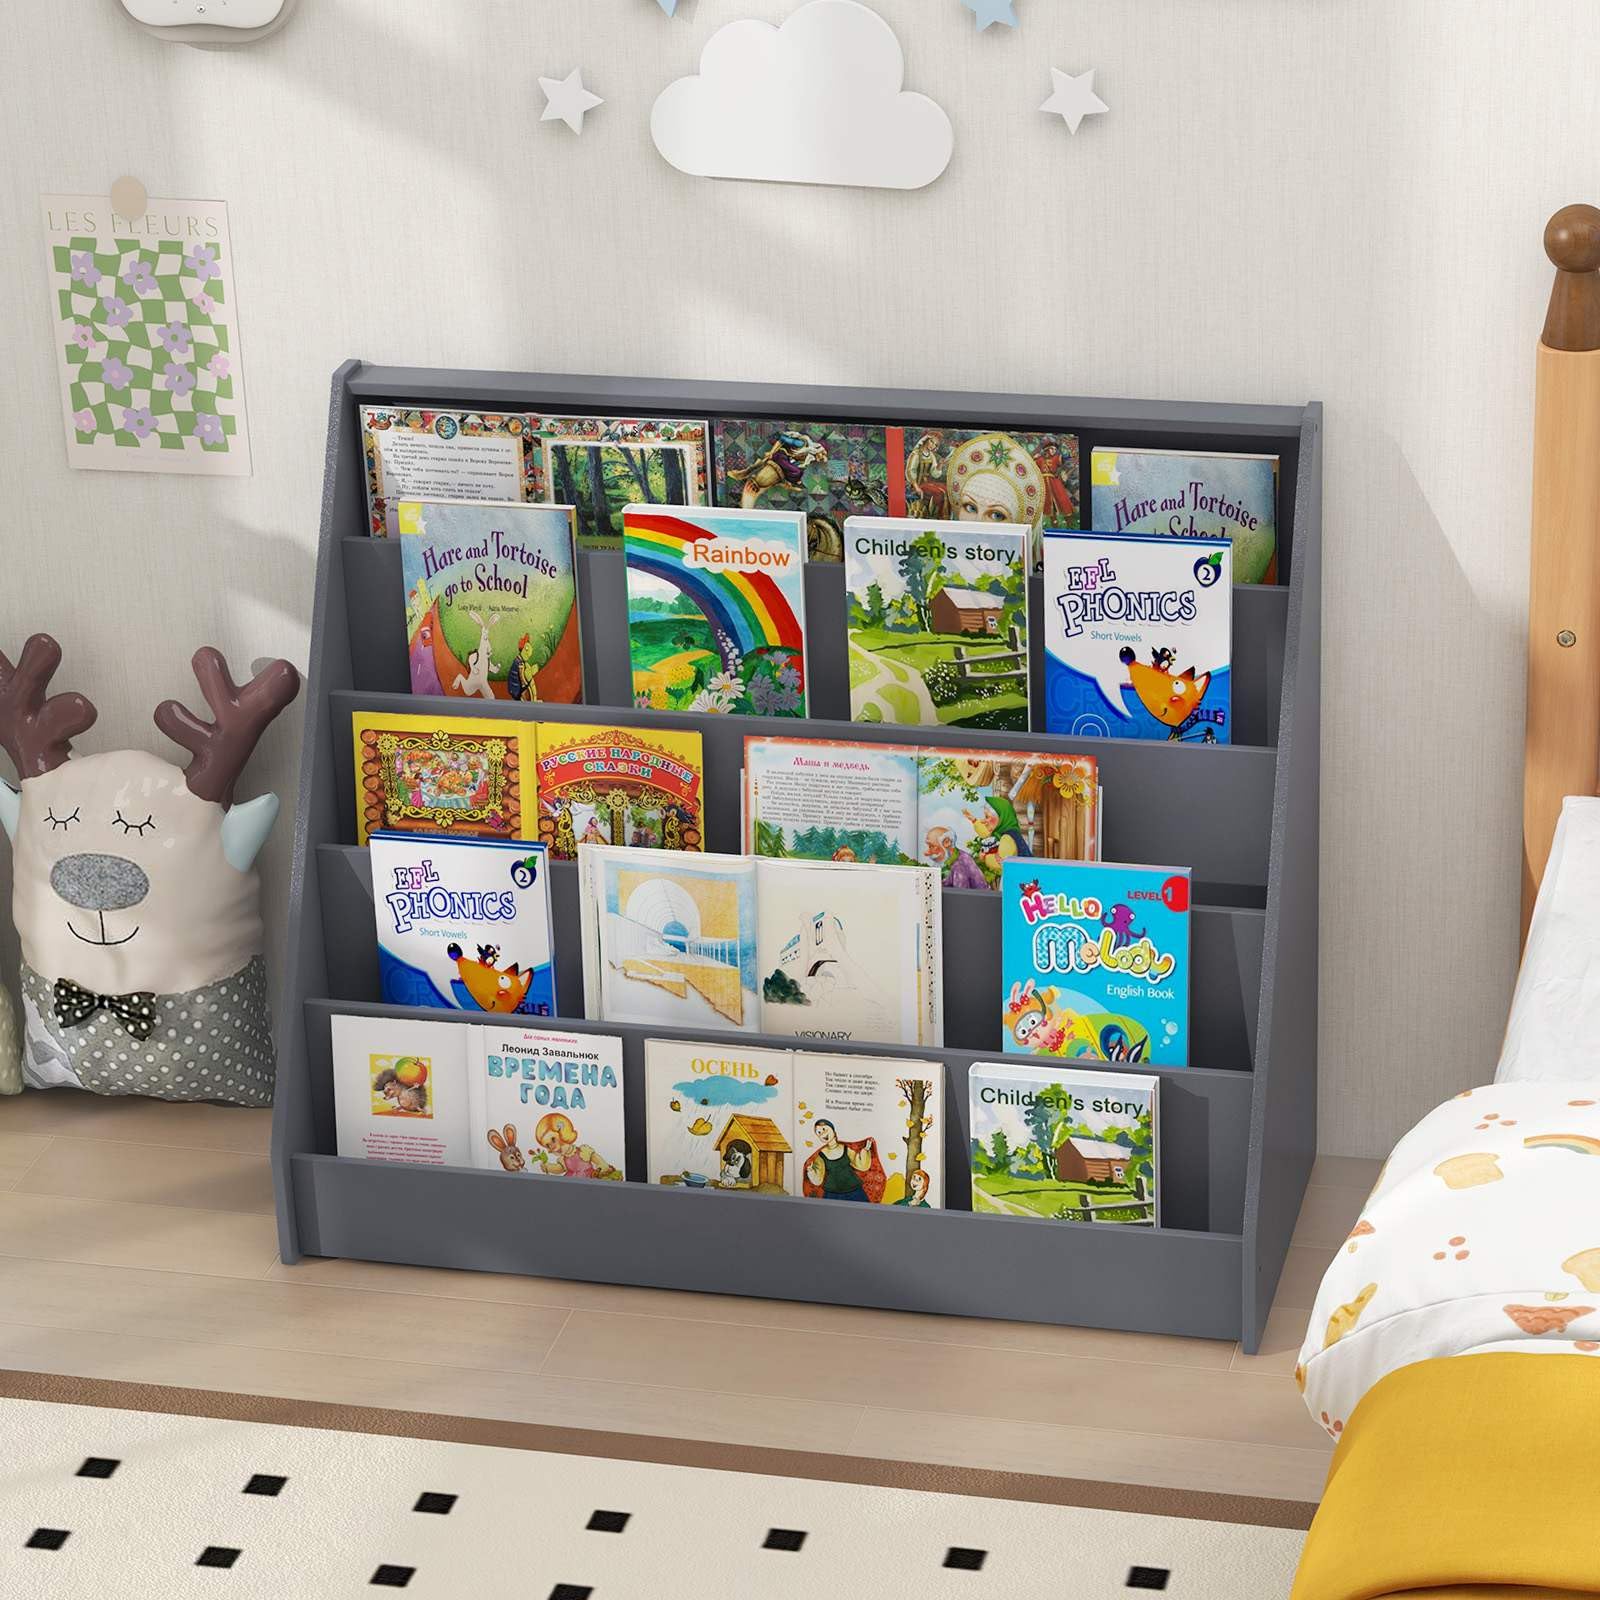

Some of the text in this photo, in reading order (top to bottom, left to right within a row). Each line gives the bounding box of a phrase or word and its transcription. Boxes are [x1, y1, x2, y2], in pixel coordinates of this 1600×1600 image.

[48, 211, 219, 237] LES FLEURS
[1113, 481, 1258, 532] Hare and Tortoise
[422, 530, 557, 580] Hare and Tortoise
[693, 544, 790, 567] Rainbow
[855, 538, 1016, 566] Children's story
[444, 562, 528, 607] go to School
[1068, 558, 1117, 590] EFL
[1056, 586, 1197, 638] PHONICS
[1090, 630, 1142, 642] Short Vowels
[541, 747, 694, 783] РУССКИЕ НАРОДНЫЕ
[583, 761, 652, 778] СКАЗКИ
[394, 859, 439, 890] EFL
[1021, 891, 1102, 925] HELLO
[1127, 886, 1173, 902] LEVEL 1
[386, 886, 517, 934] PHONICS
[419, 928, 468, 939] Short Vowels
[1106, 984, 1175, 999] English Book
[502, 1044, 600, 1061] Леонид Завальнюк
[487, 1054, 618, 1089] ВРЕМЕНА
[690, 1057, 760, 1080] ОСЕНЬ
[519, 1083, 587, 1110] ГОДА
[980, 1087, 1144, 1119] Children's story
